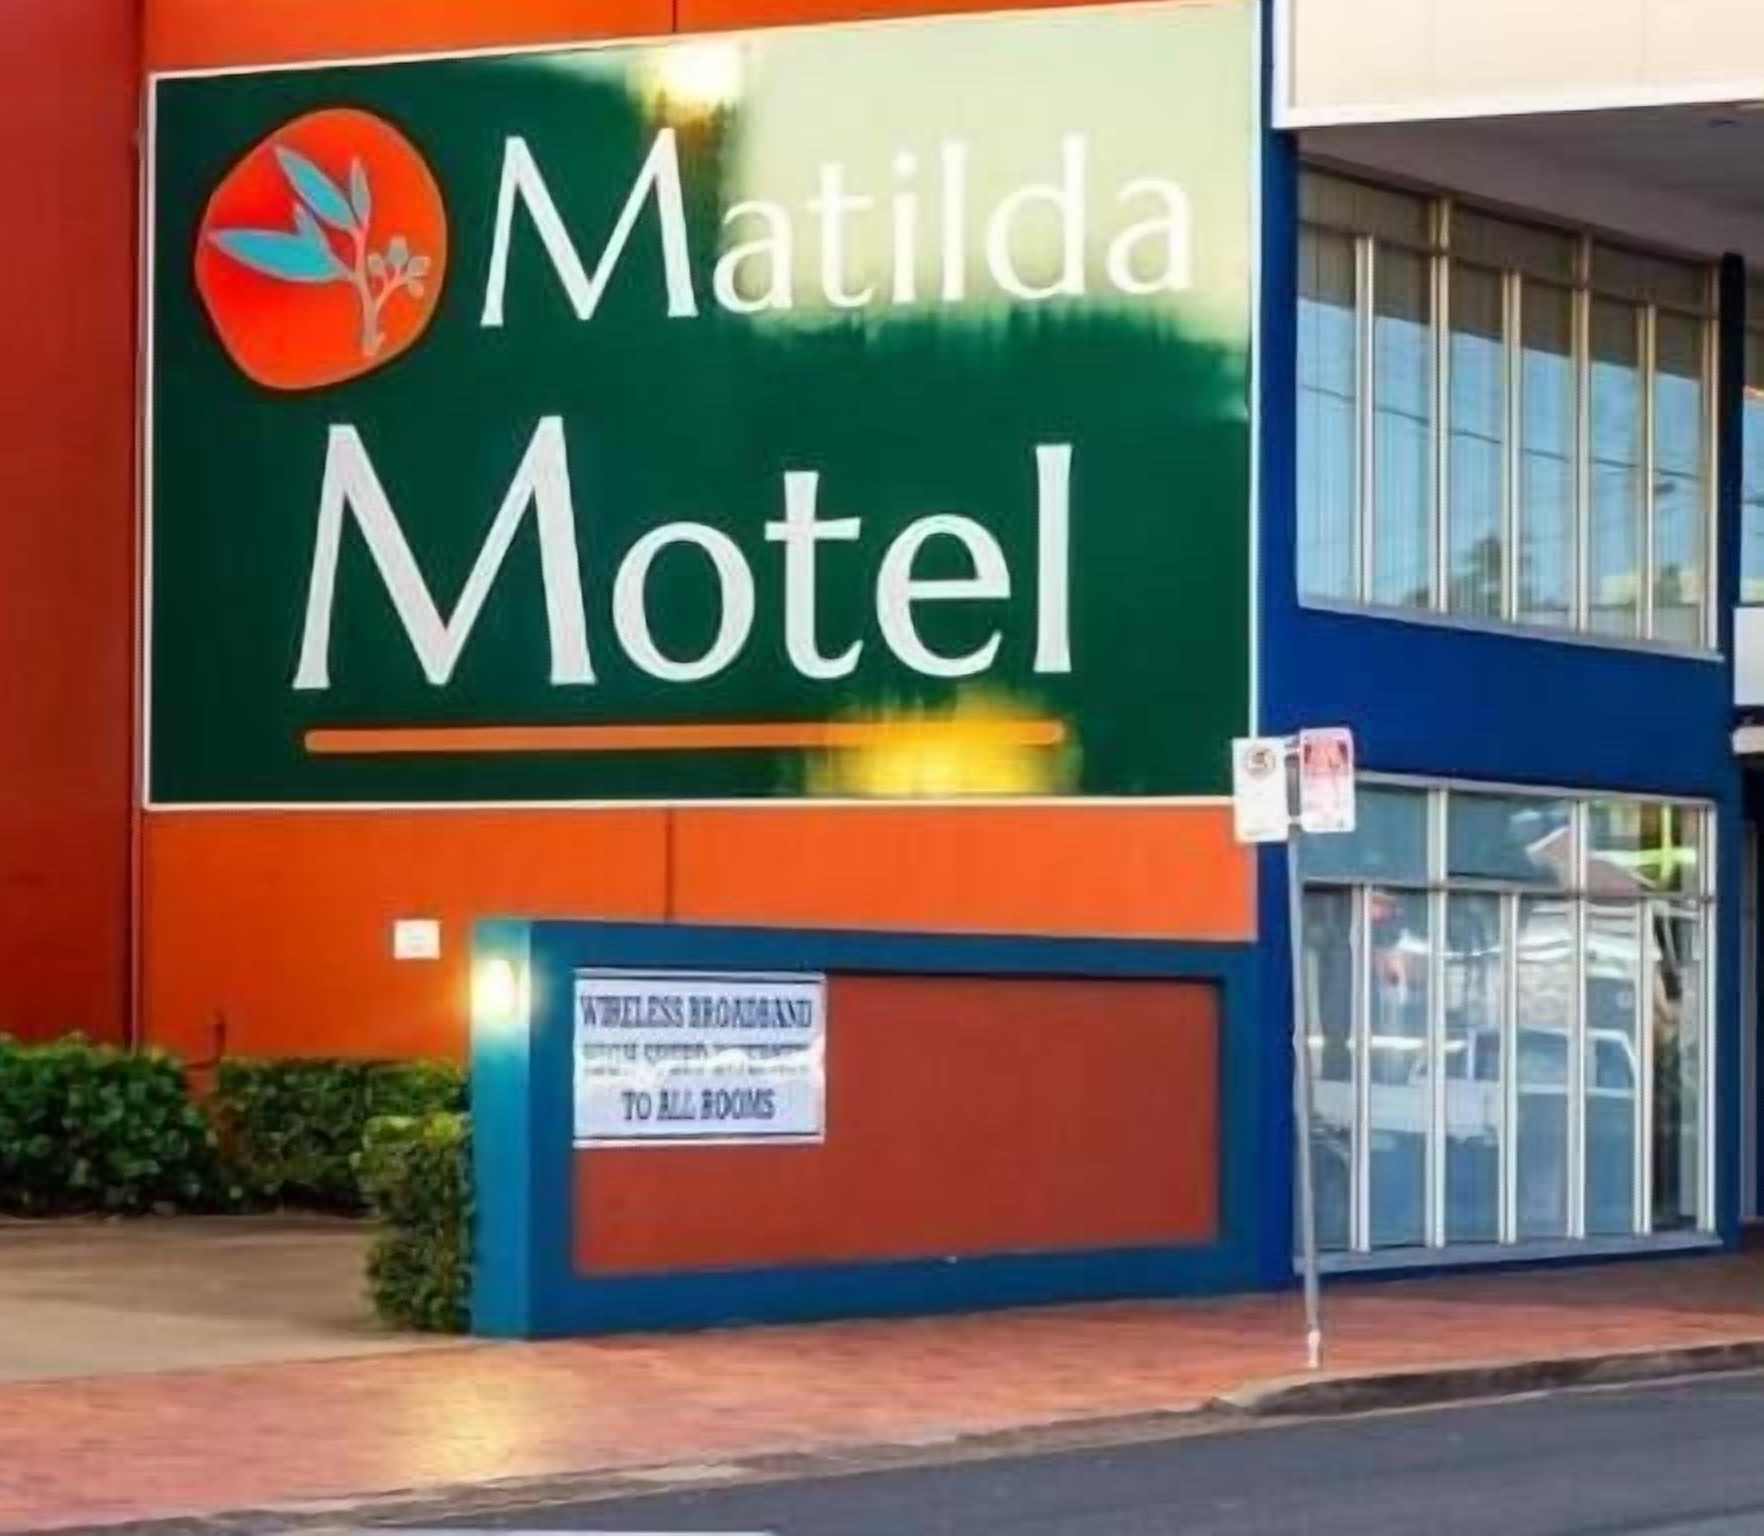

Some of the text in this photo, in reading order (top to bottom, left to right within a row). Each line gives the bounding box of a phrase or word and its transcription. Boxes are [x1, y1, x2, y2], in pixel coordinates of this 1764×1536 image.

[480, 126, 1193, 329] Matilda
[292, 414, 1073, 690] Motel
[621, 1089, 776, 1121] TO ALL ROOMS
